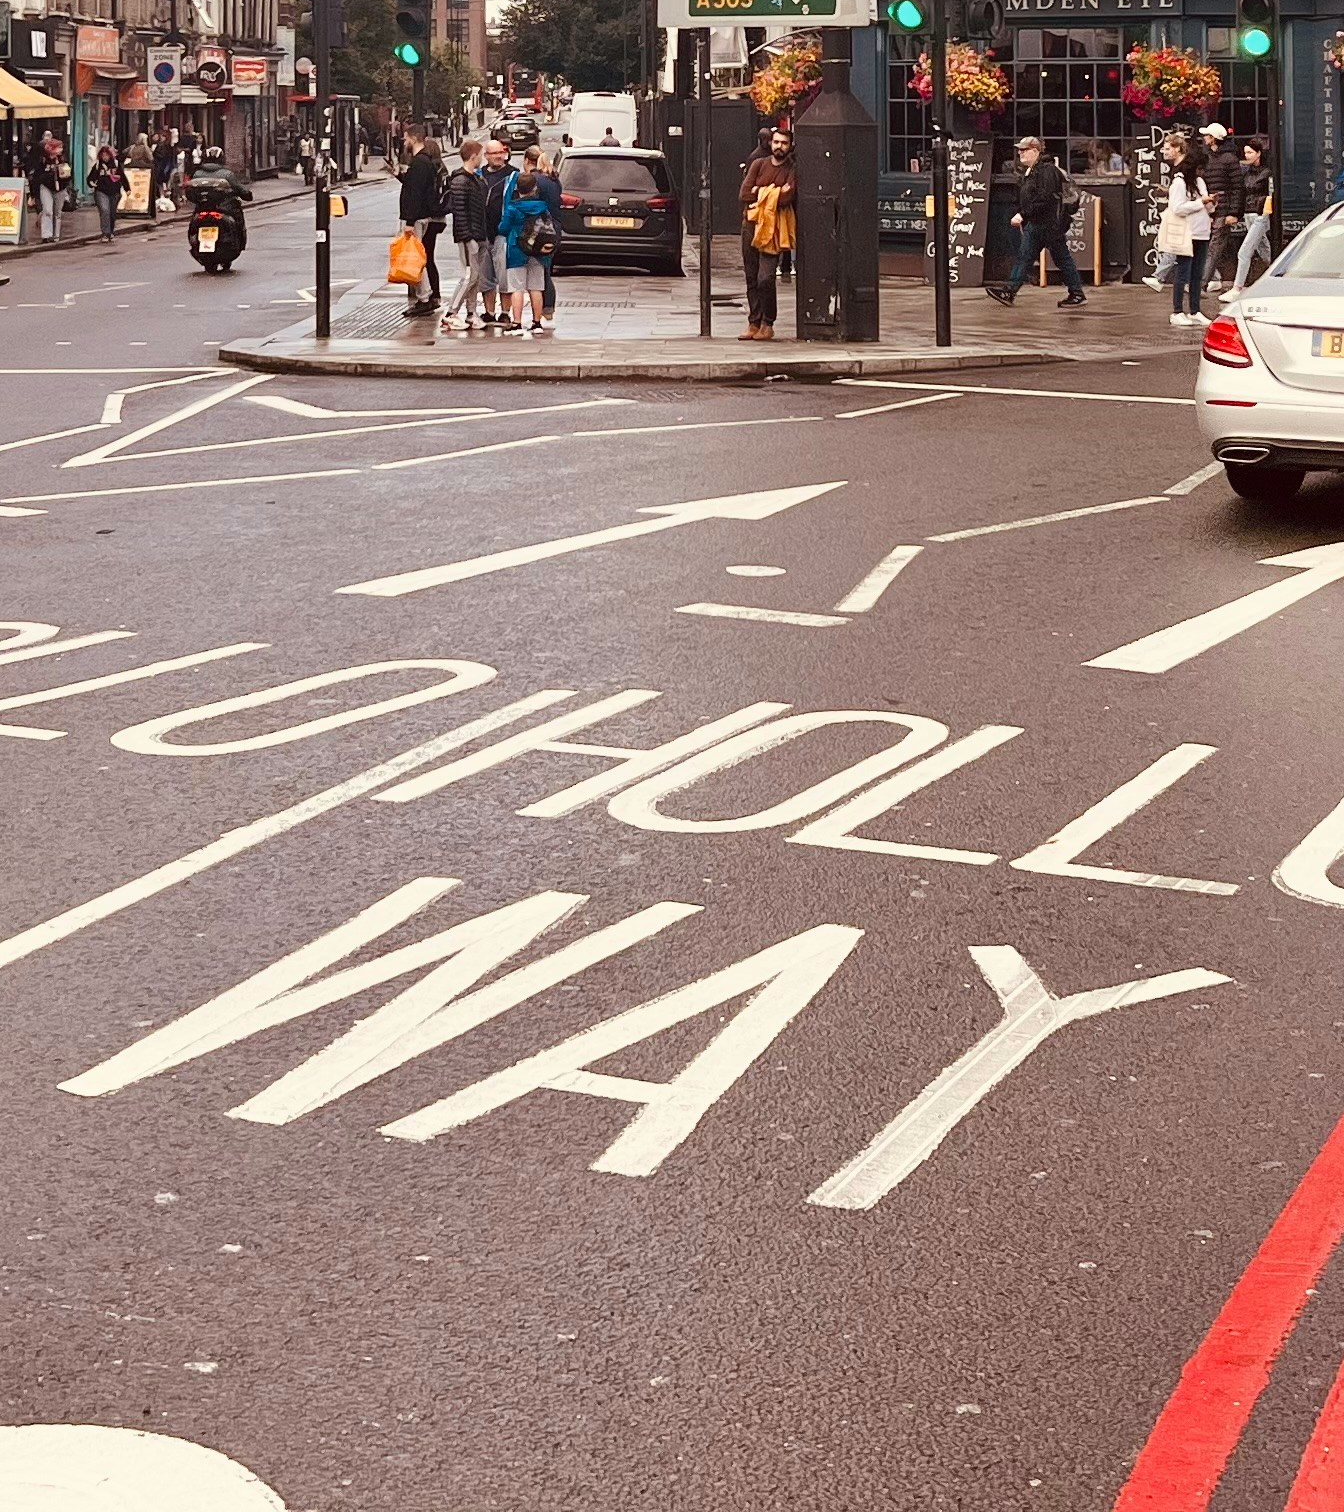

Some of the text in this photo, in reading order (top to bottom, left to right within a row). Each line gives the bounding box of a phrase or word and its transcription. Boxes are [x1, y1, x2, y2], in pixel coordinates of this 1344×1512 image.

[1323, 103, 1333, 150] BEER
[1323, 154, 1333, 165] &
[56, 877, 1238, 1211] WAY
